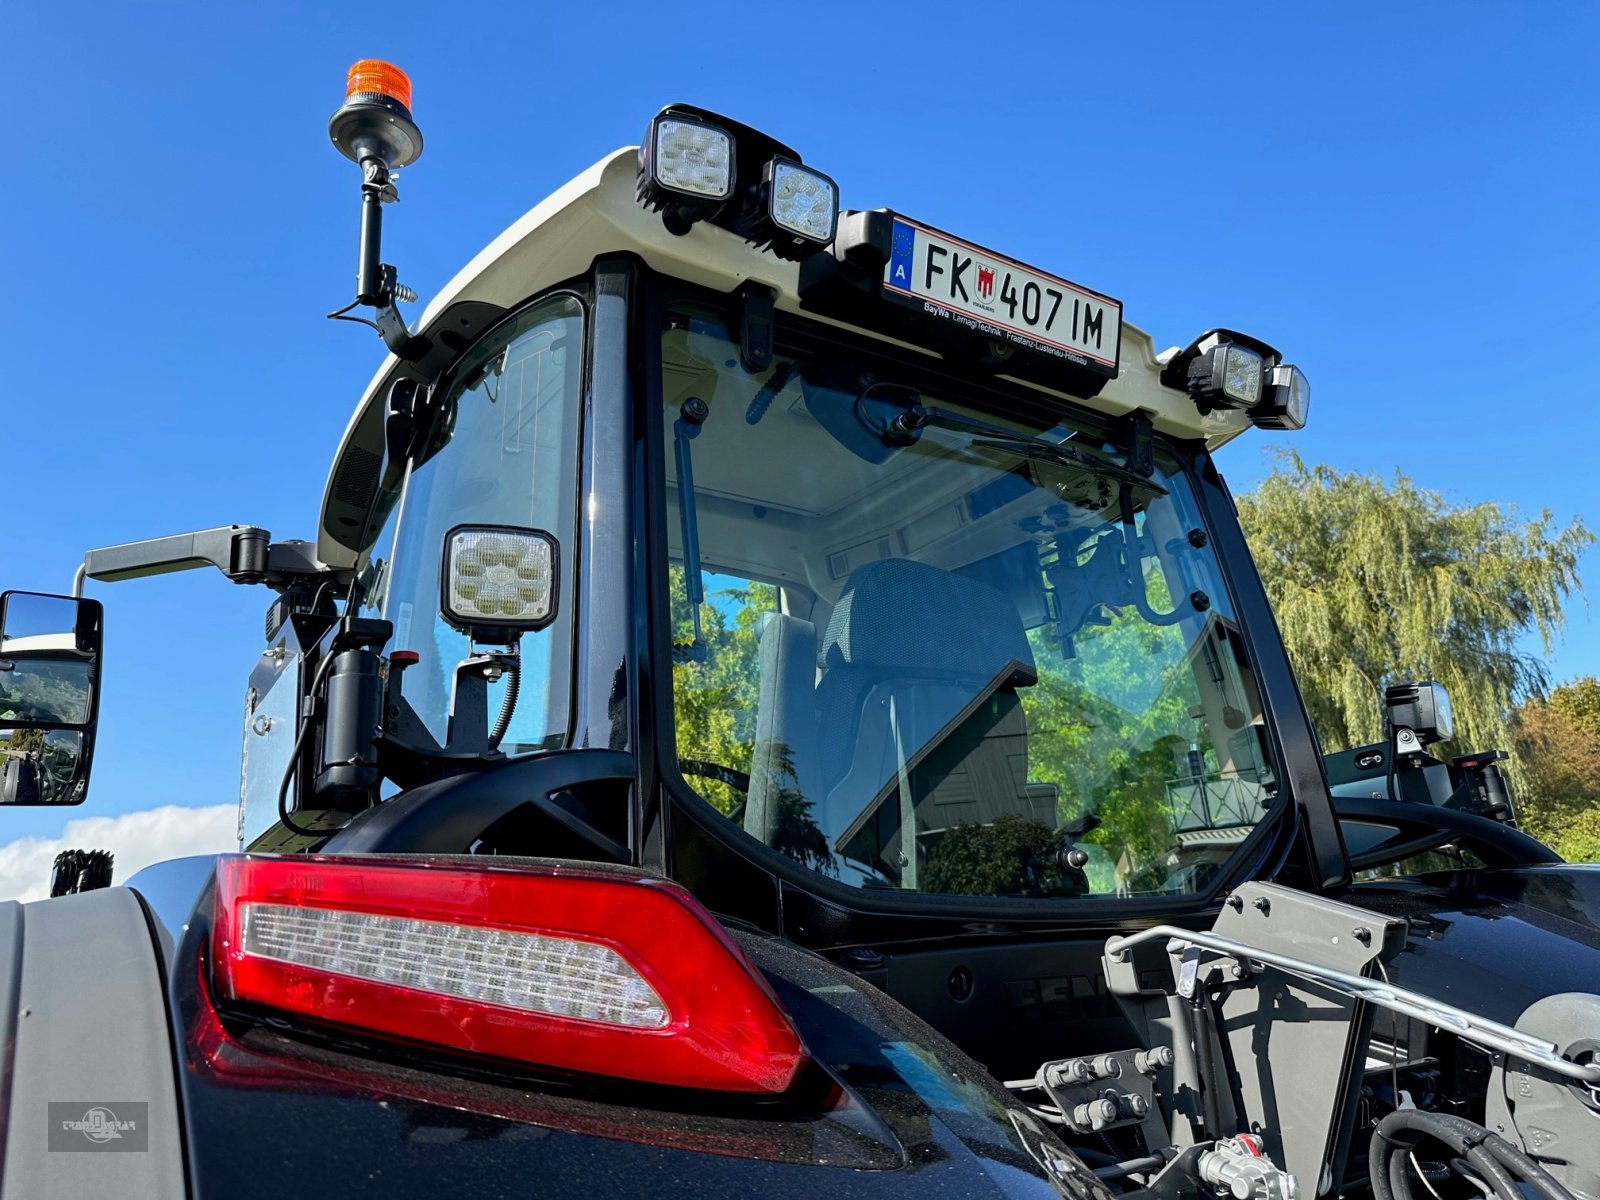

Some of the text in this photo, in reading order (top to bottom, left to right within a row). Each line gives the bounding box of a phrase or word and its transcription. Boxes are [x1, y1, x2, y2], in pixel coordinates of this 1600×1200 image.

[895, 264, 906, 280] A
[925, 243, 1103, 350] FK 407 IM
[924, 302, 950, 318] BayWa
